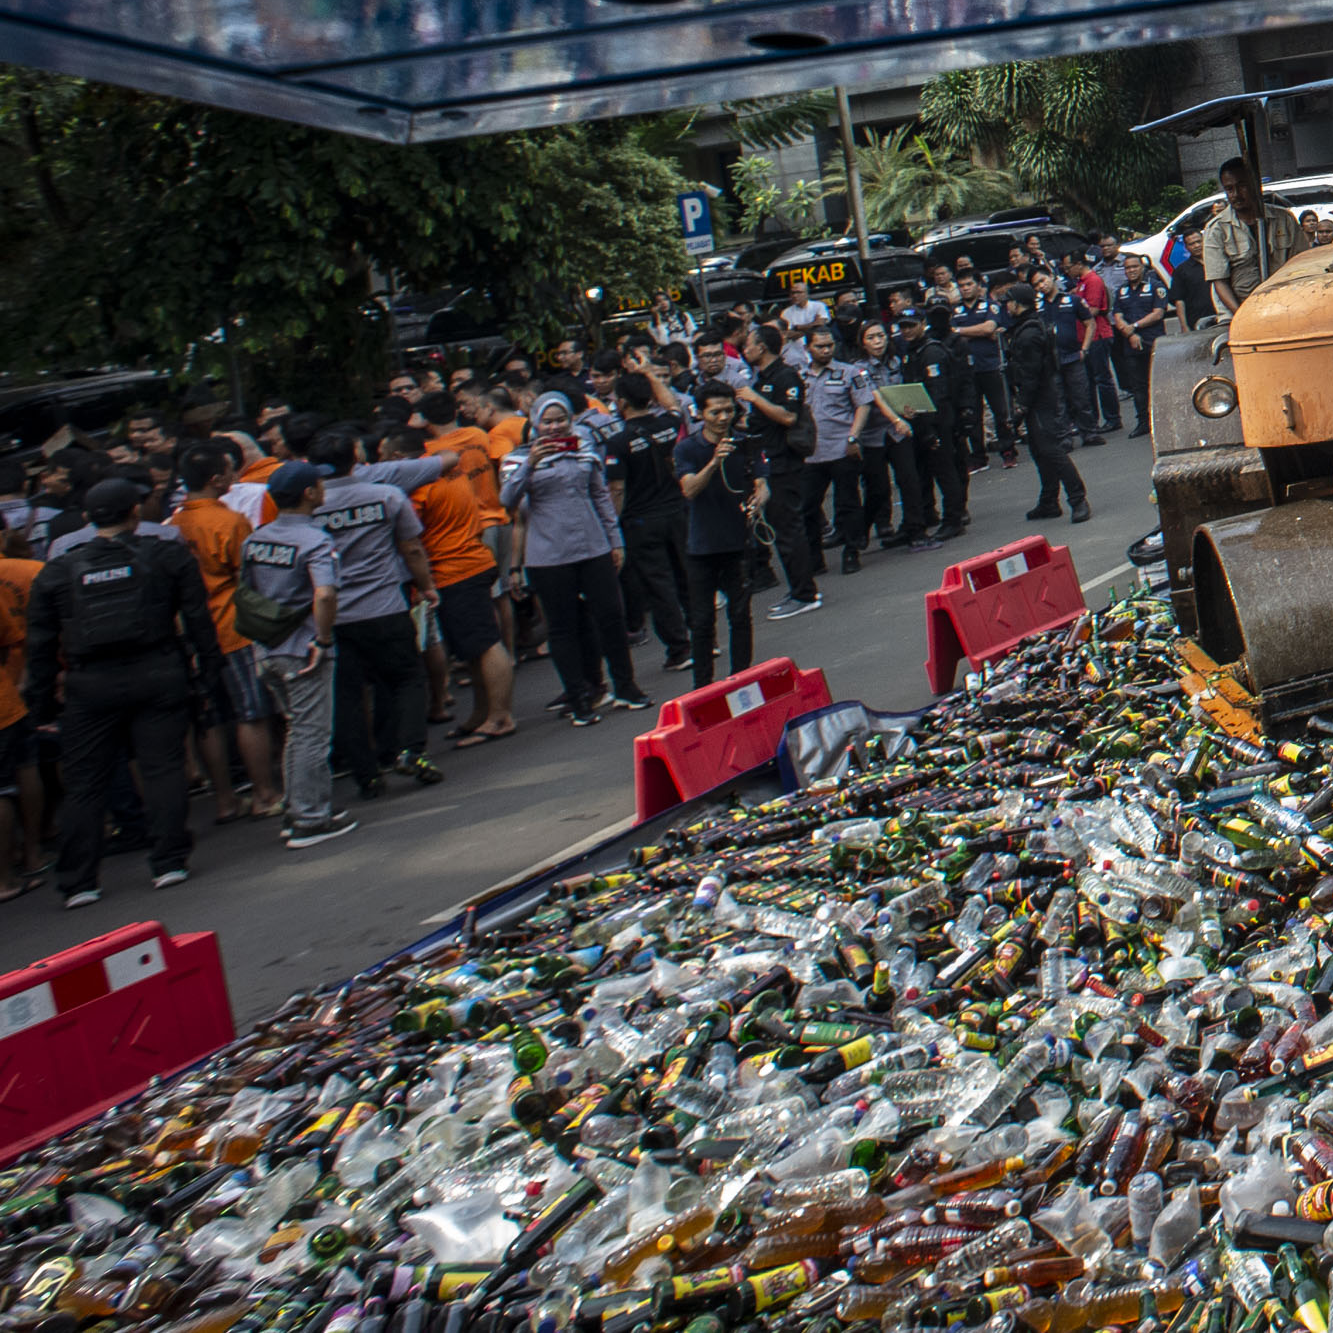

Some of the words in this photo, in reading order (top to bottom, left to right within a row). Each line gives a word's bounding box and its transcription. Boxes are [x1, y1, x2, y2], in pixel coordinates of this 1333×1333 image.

[682, 197, 703, 233] P
[776, 261, 846, 289] TEKAB
[315, 503, 384, 532] POLISI
[246, 542, 297, 566] POLISI
[82, 566, 132, 586] POLISI
